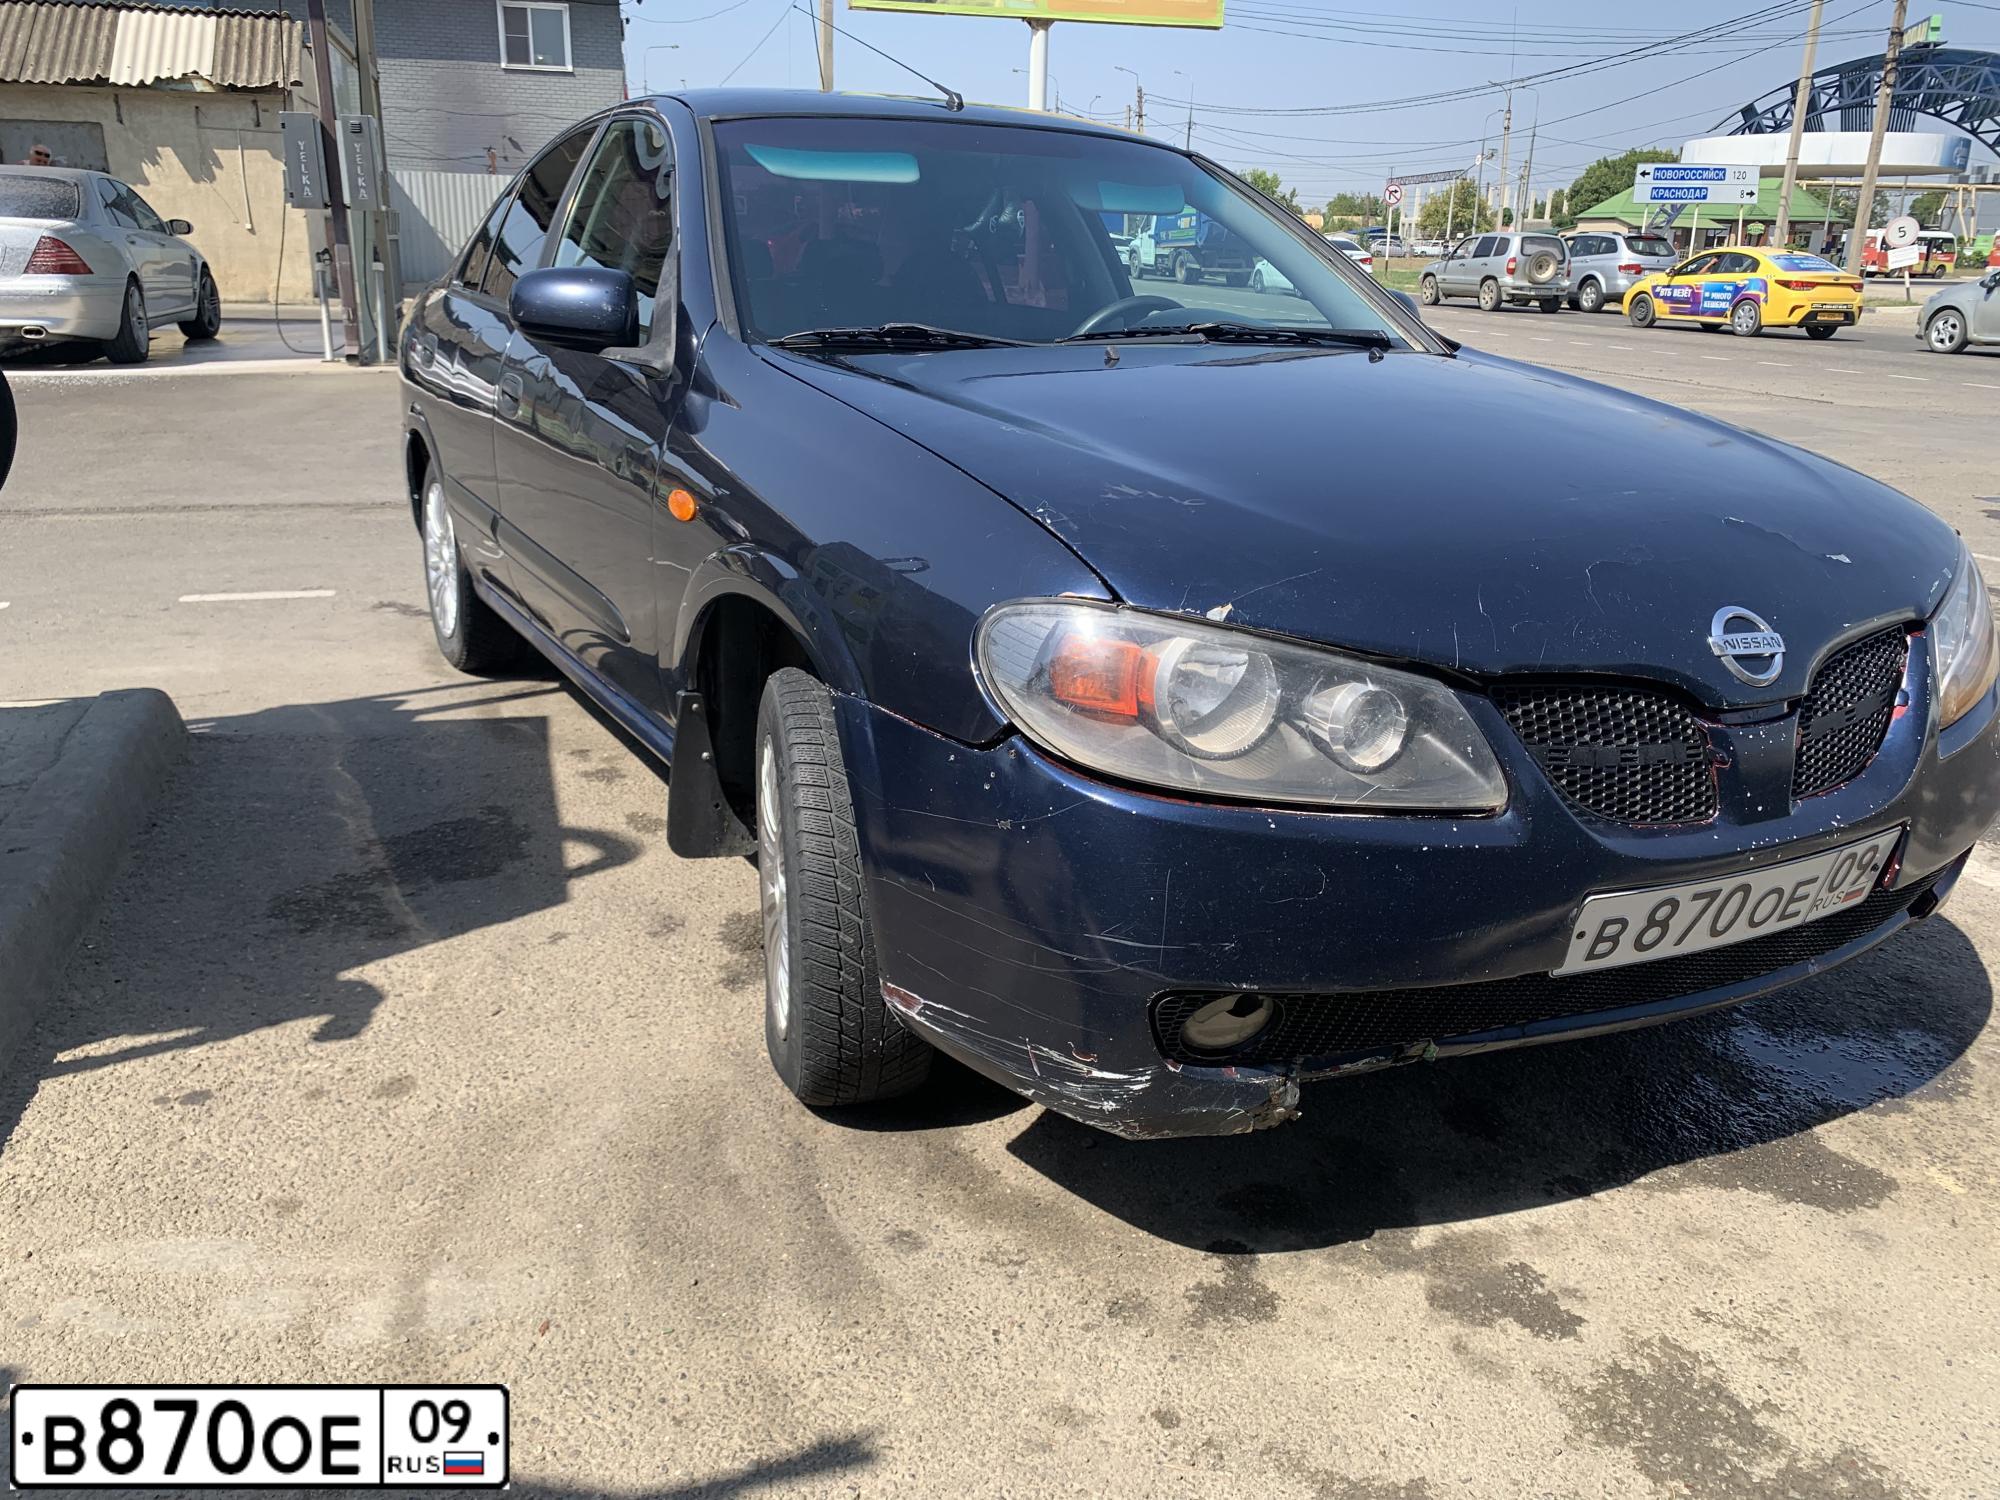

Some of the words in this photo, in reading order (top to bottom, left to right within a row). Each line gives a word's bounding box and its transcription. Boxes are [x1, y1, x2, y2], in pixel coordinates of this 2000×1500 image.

[297, 140, 312, 197] YELKA
[1654, 168, 1725, 180] НОВОРОССИЙСК
[1733, 171, 1747, 180] 120
[1651, 188, 1707, 200] КРАСНОДАР
[1740, 189, 1745, 199] 8
[1898, 225, 1907, 238] 5
[1723, 636, 1782, 651] NISSAN
[1827, 844, 1879, 894] 09
[1812, 890, 1844, 913] RUS
